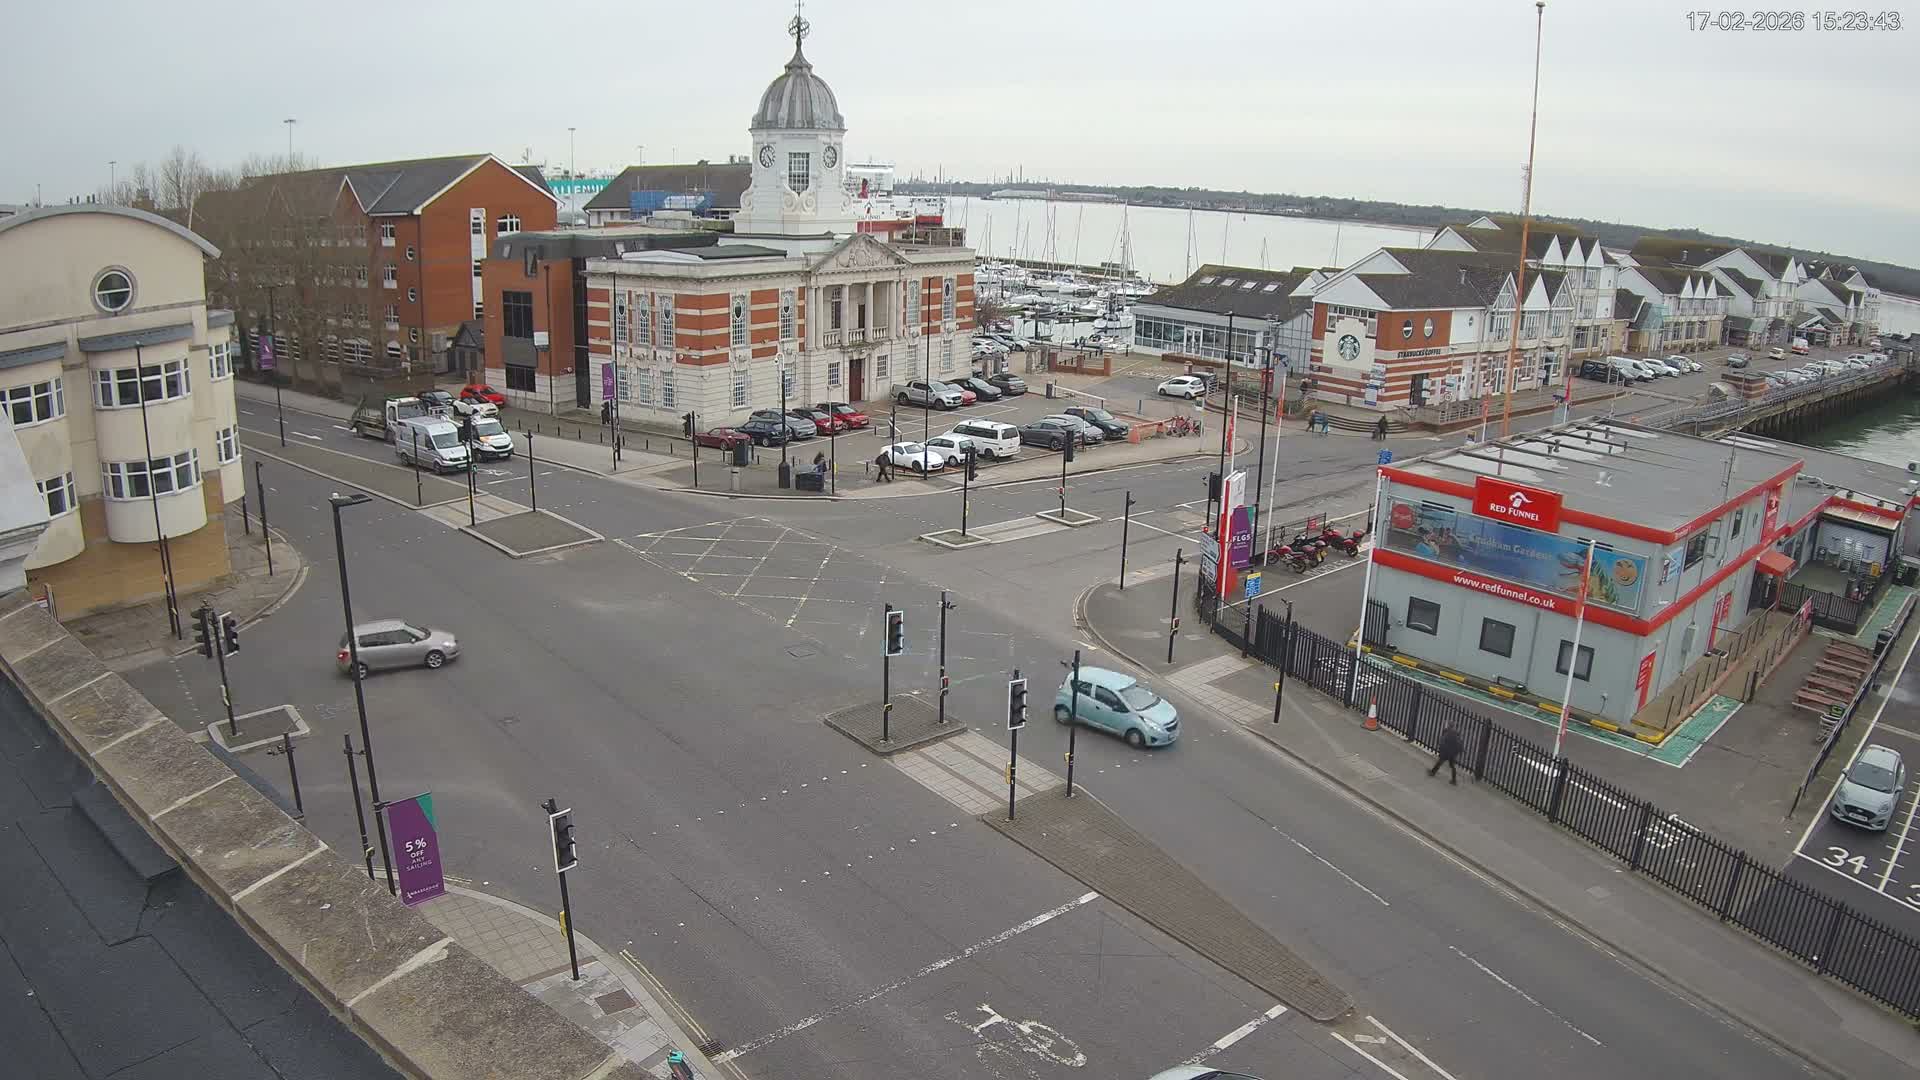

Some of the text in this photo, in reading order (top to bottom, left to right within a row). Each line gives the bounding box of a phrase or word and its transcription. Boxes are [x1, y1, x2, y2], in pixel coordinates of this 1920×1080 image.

[1397, 348, 1441, 358] STARBUCKS COFFEE
[1489, 502, 1541, 522] RED FUNNEL
[1453, 573, 1556, 609] www.redfunnel.co.uk
[410, 850, 425, 858] OFF
[1822, 846, 1869, 875] 34
[406, 860, 432, 871] SAILING
